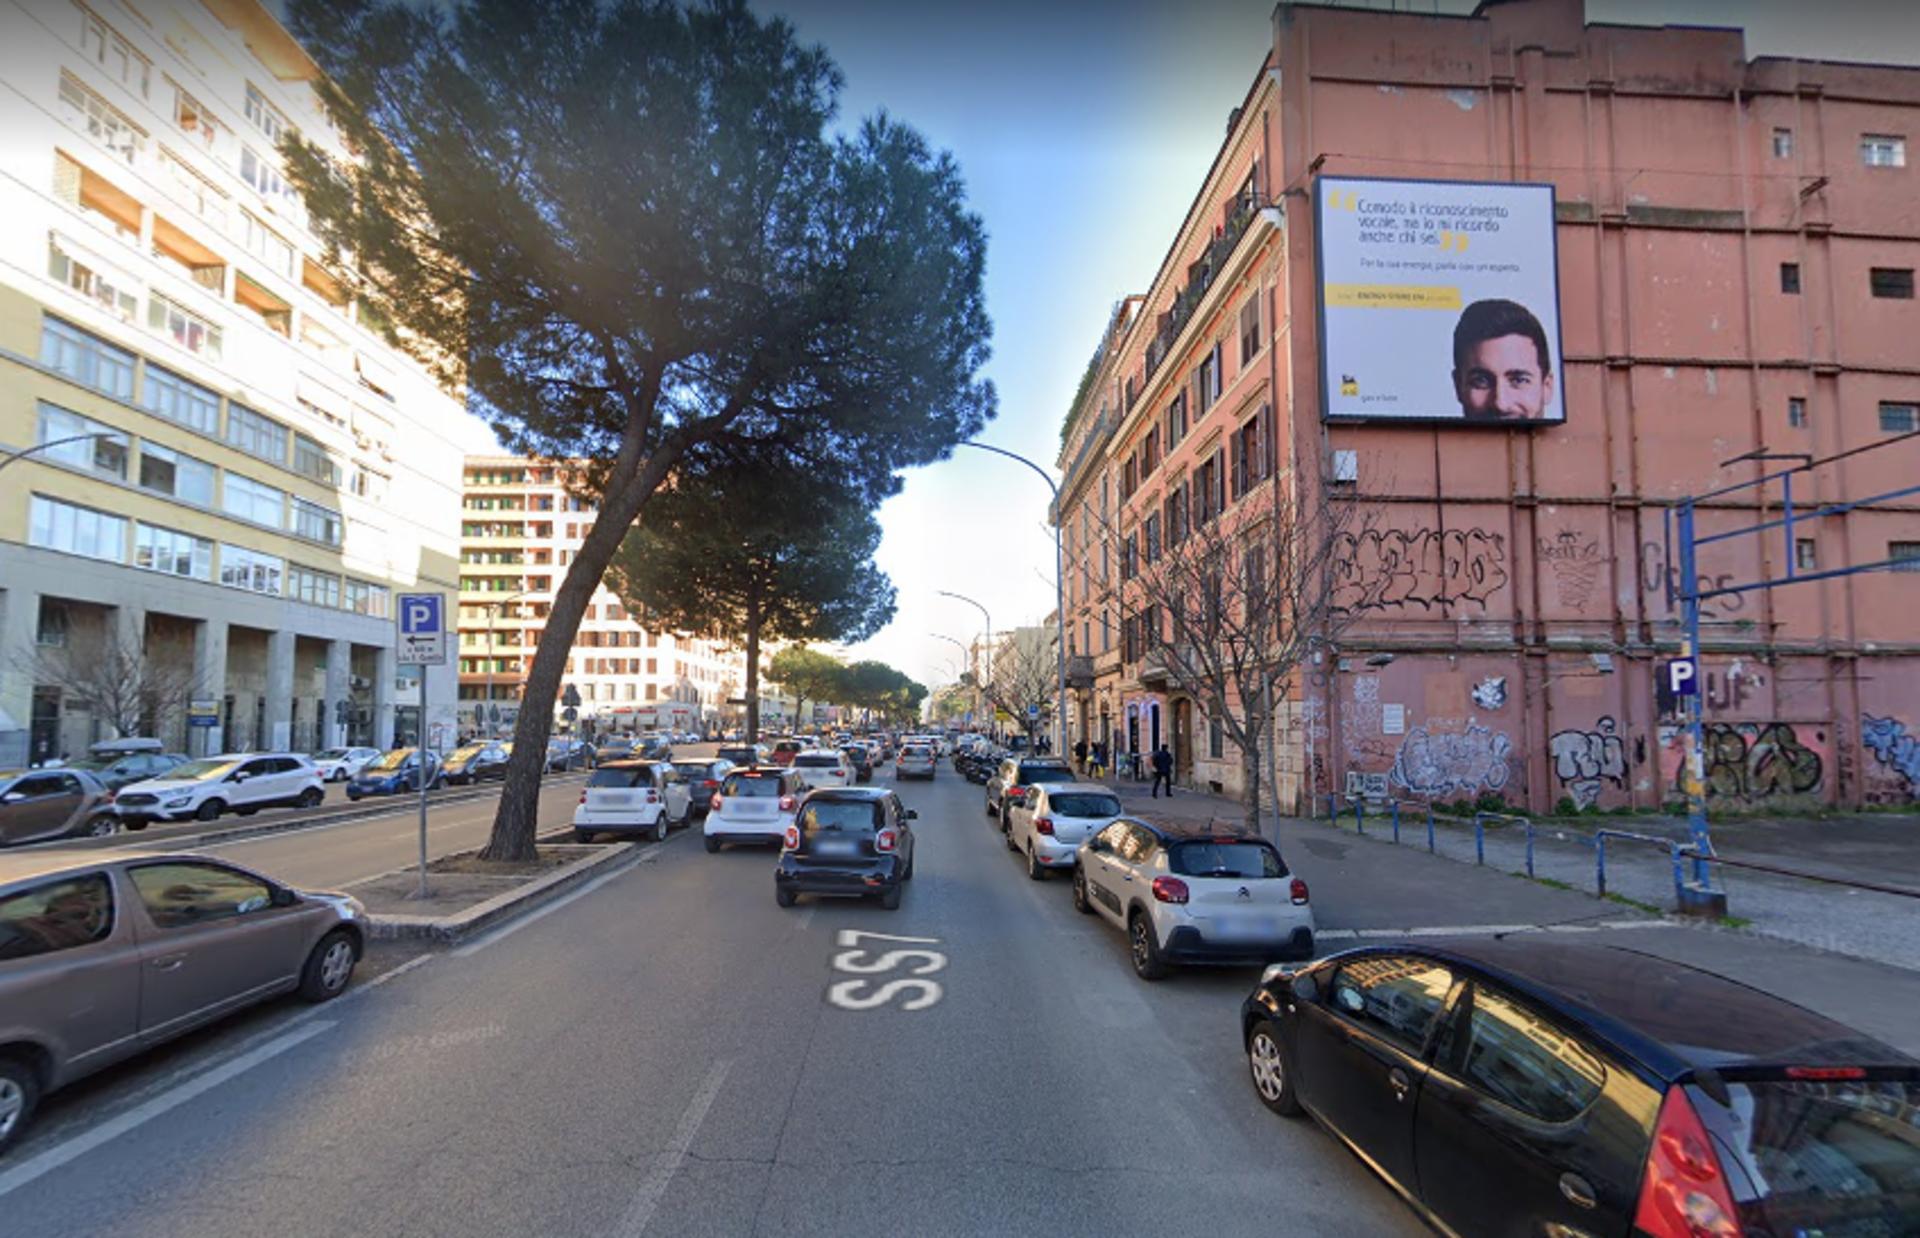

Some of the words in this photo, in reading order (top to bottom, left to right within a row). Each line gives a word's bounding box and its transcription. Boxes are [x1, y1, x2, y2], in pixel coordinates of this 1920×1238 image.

[1358, 229, 1395, 243] anche
[1399, 230, 1416, 244] chi
[409, 605, 431, 633] P
[1670, 661, 1695, 692] P
